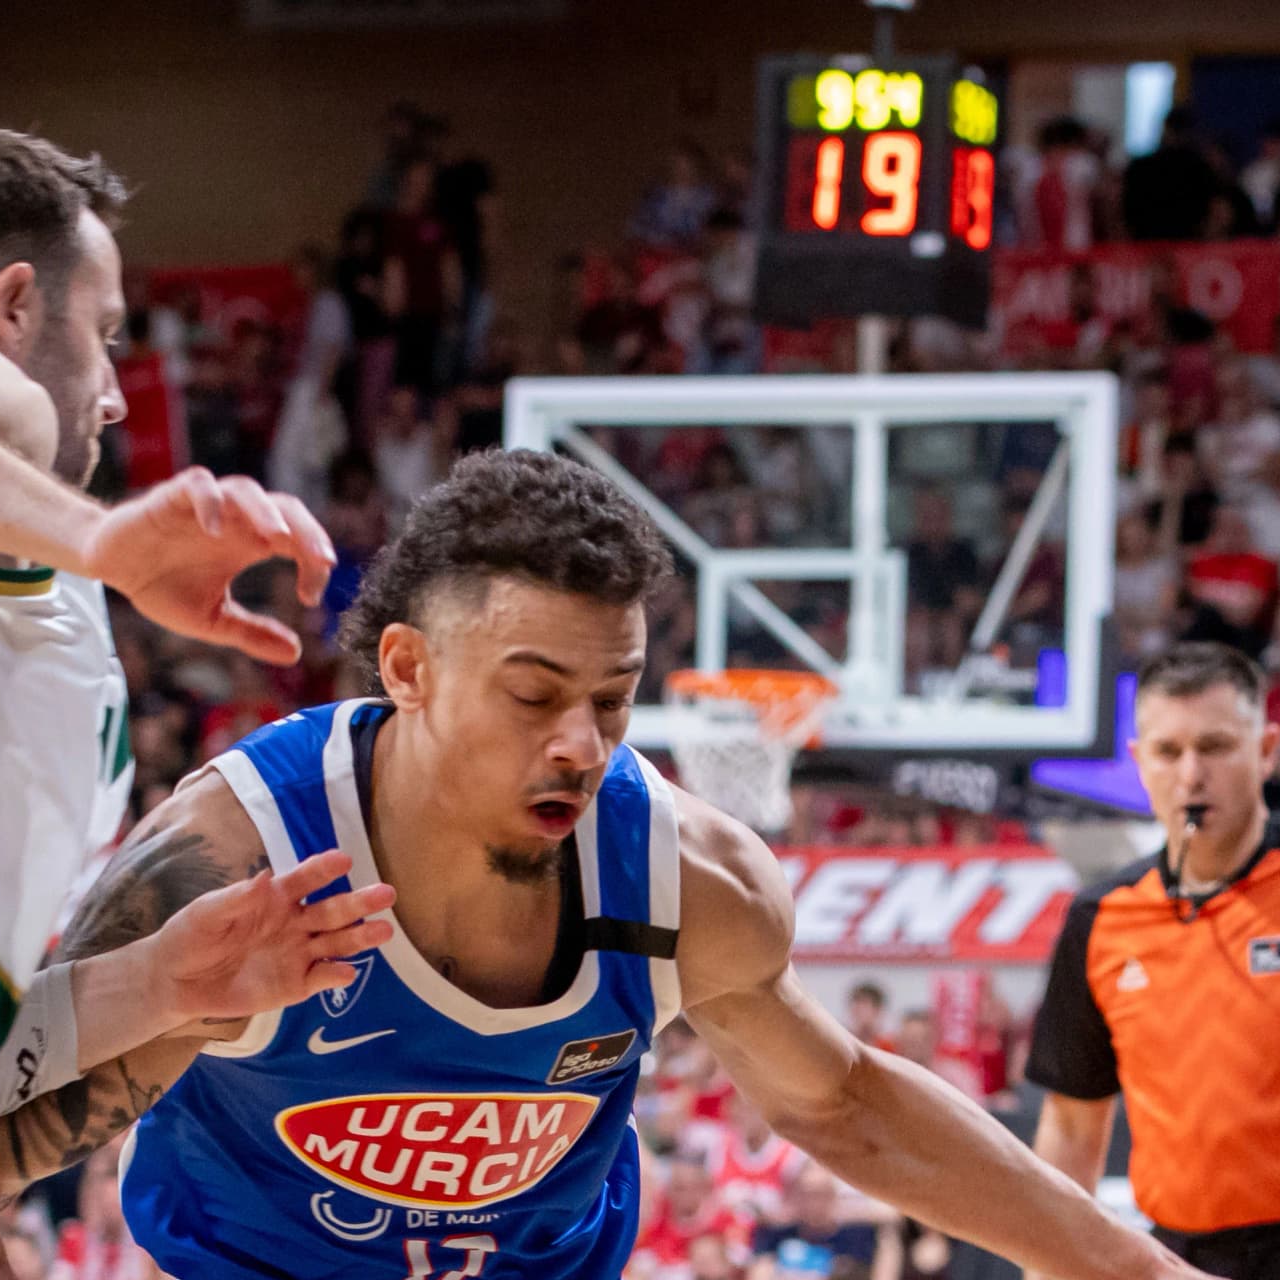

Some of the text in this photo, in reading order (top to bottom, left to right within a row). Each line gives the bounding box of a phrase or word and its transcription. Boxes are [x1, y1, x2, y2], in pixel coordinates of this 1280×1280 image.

[812, 130, 923, 236] 19
[772, 856, 1080, 946] ENT
[346, 1101, 567, 1146] UCAM
[303, 1132, 570, 1197] MURCIA
[406, 1209, 440, 1229] DE
